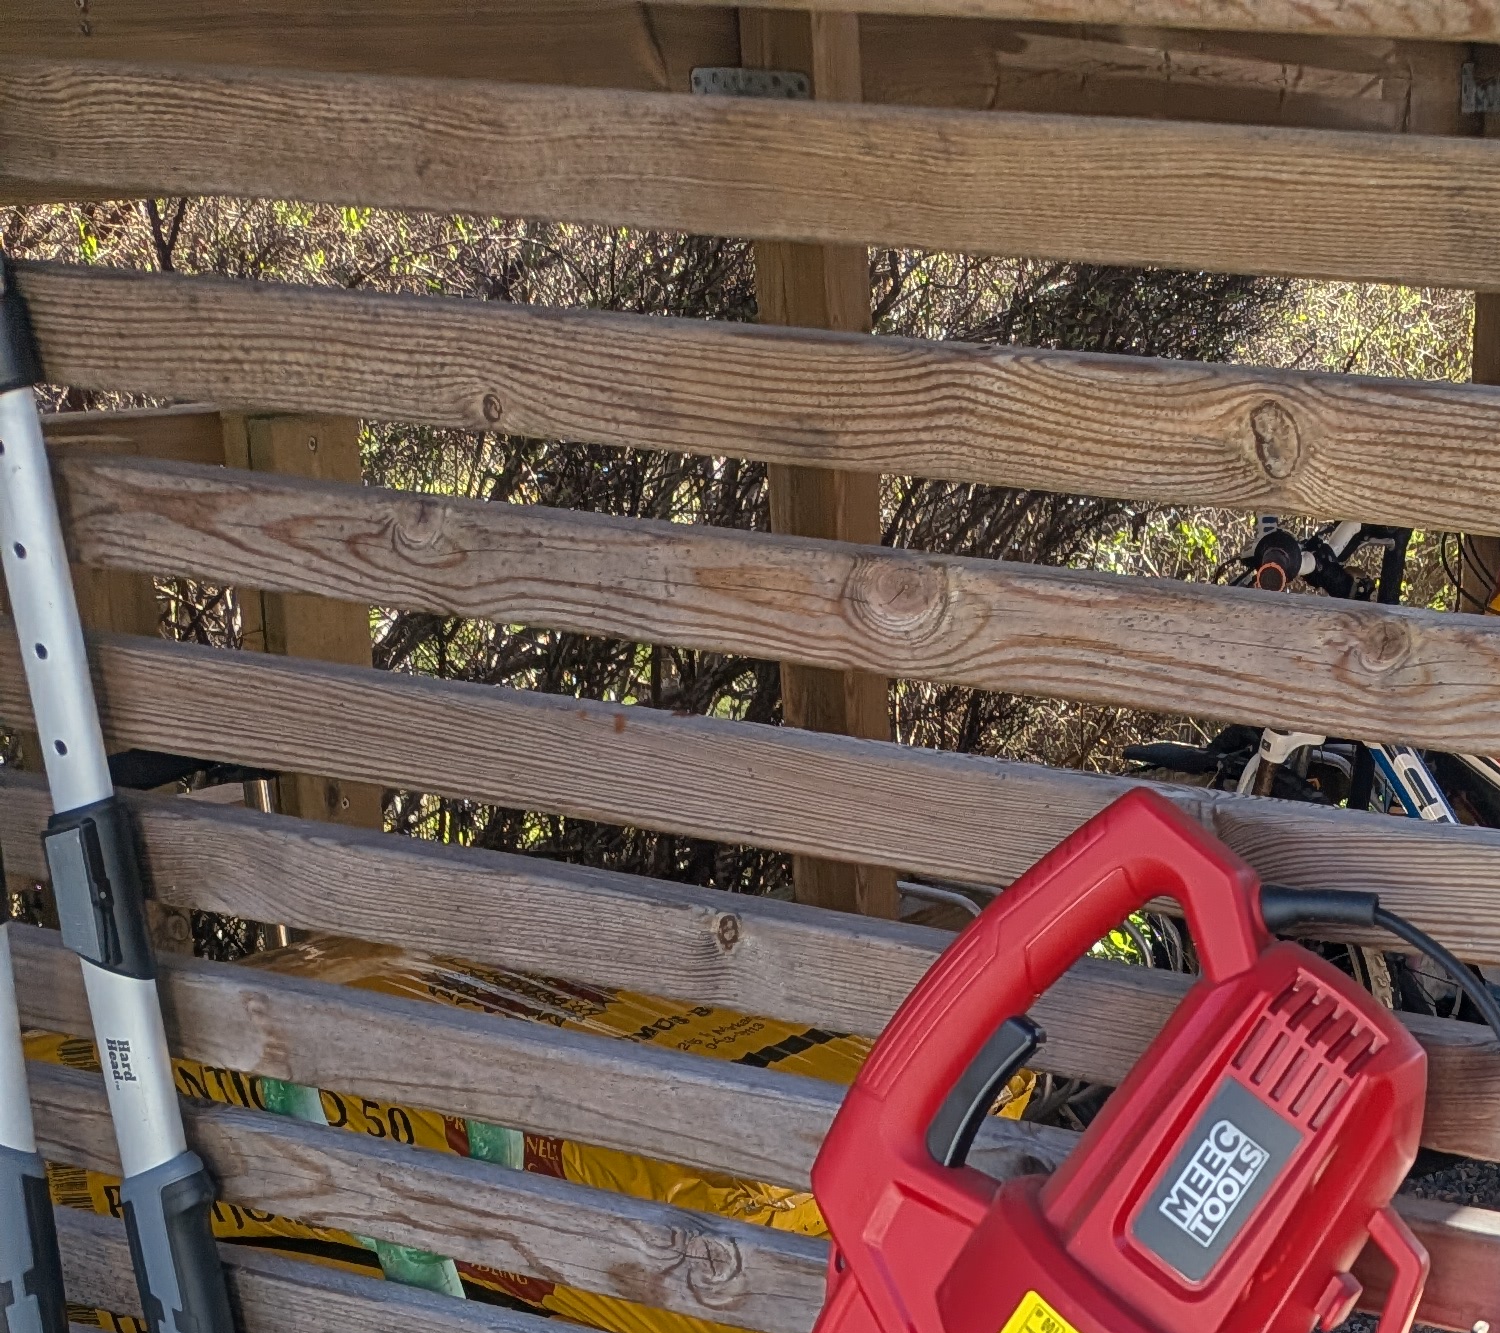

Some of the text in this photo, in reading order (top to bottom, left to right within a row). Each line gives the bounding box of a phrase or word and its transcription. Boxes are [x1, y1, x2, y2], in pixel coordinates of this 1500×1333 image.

[117, 1040, 137, 1081] Hard
[361, 1099, 415, 1145] 50
[1160, 1120, 1242, 1230] MEEC
[1188, 1142, 1264, 1239] TOOLS
